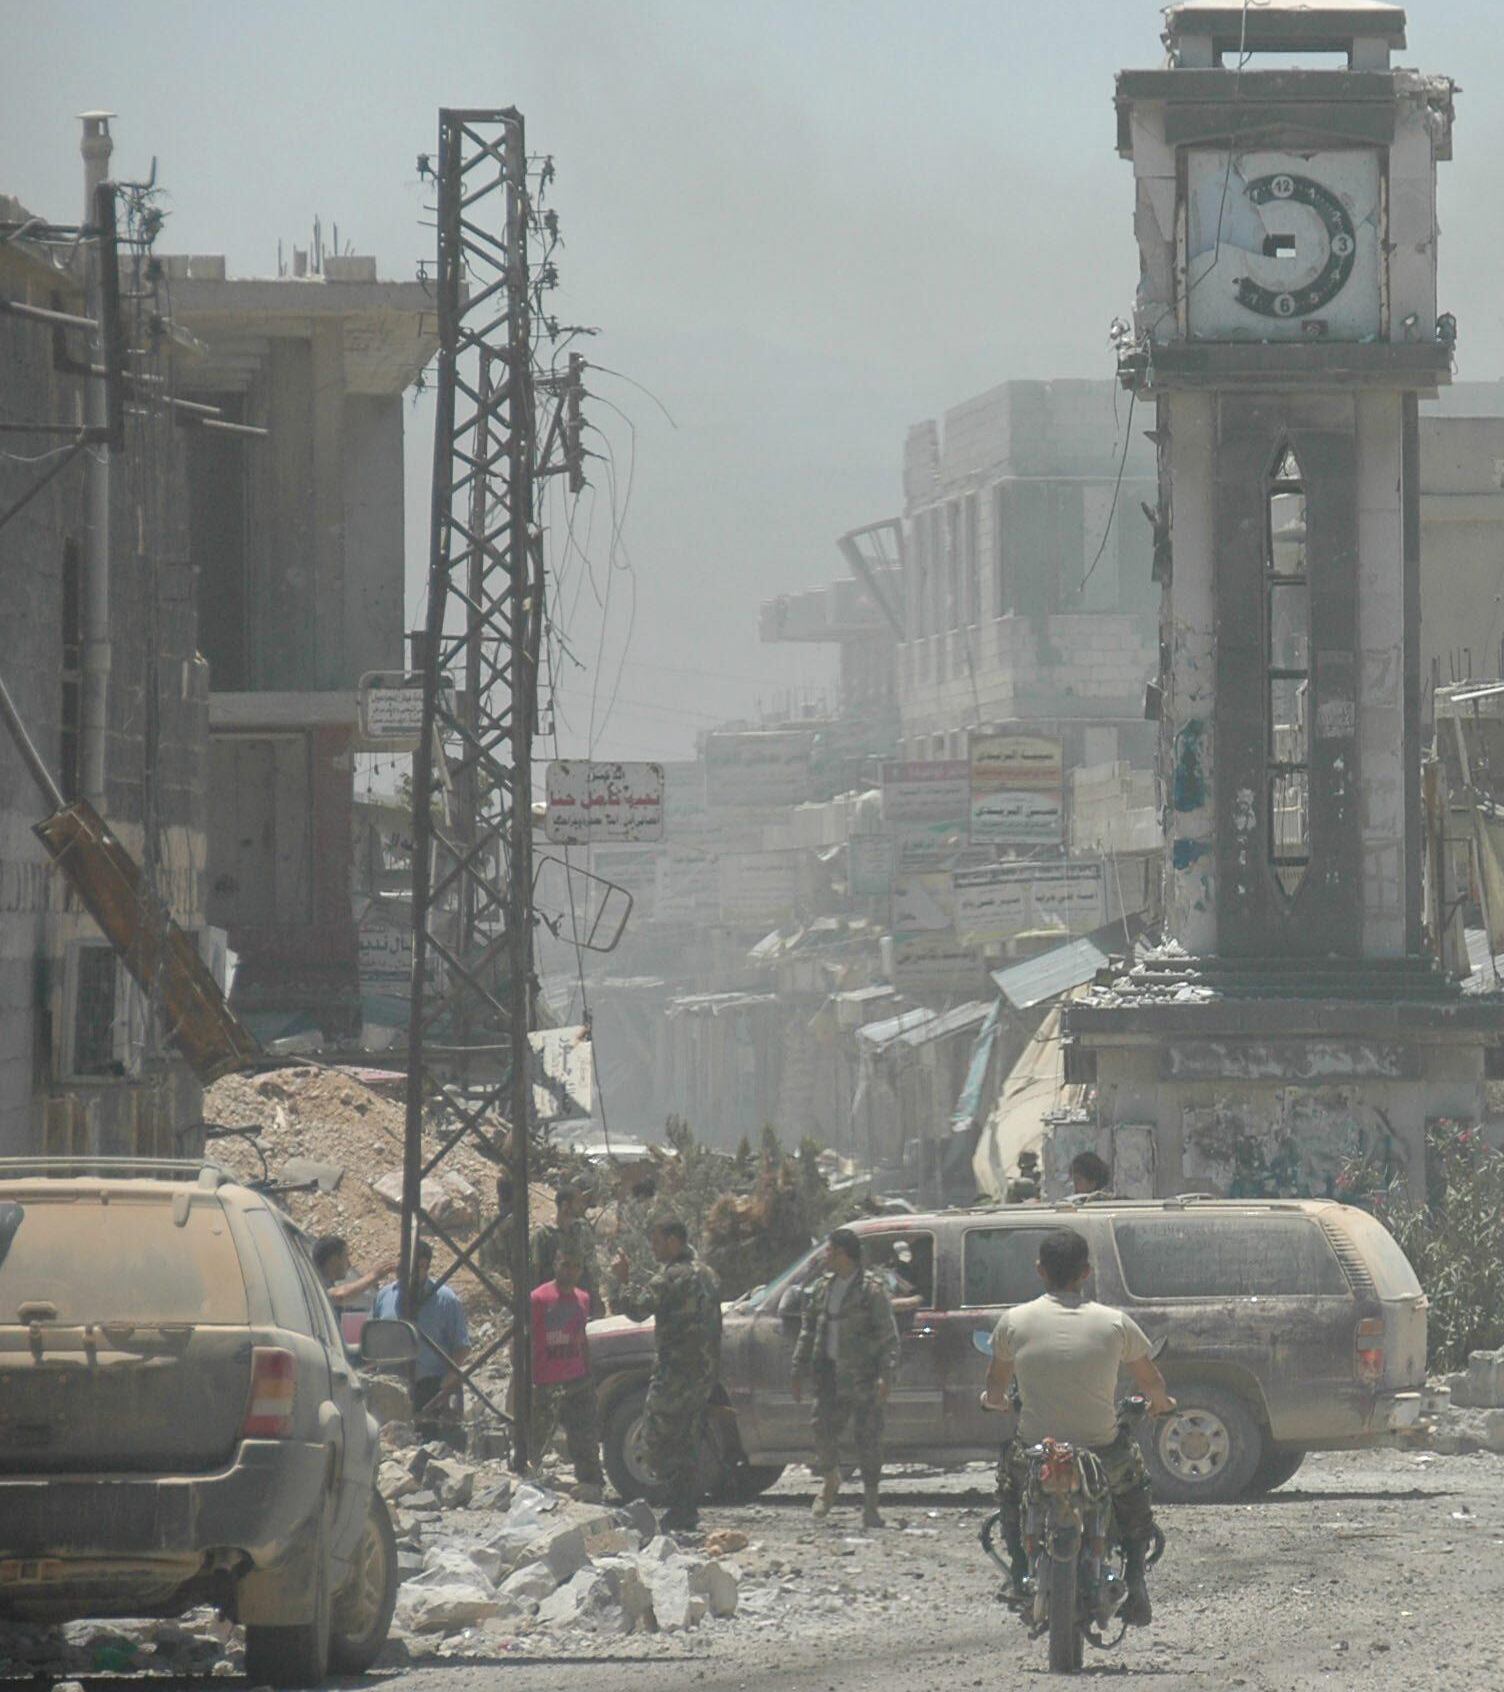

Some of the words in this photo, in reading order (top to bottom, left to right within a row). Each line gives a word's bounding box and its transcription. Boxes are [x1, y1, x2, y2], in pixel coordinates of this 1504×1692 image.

[1275, 179, 1292, 193] 12
[1337, 237, 1348, 253] 3
[1280, 297, 1291, 313] 6
